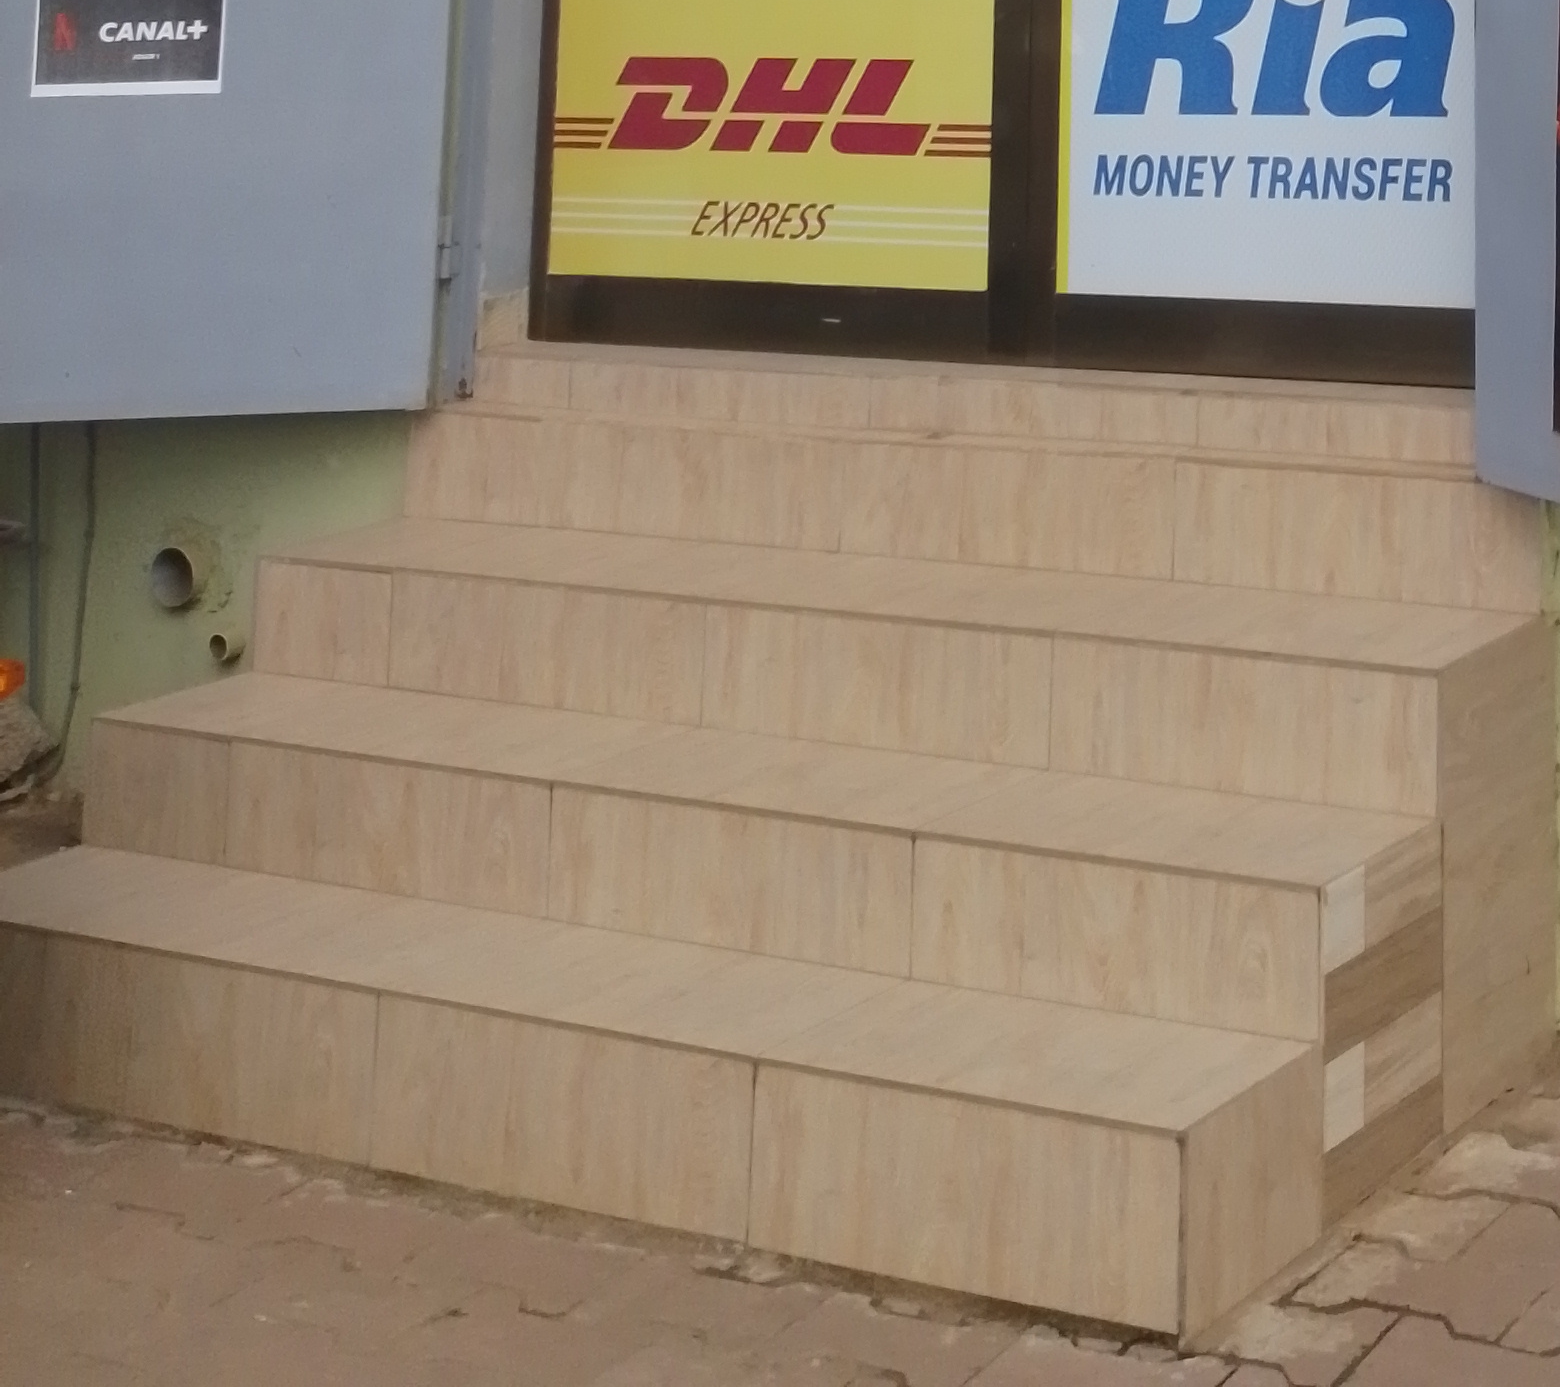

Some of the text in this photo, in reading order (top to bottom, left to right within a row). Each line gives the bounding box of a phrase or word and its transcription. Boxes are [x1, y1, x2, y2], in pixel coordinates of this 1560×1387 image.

[98, 20, 208, 43] CANAL+
[607, 57, 931, 156] DHL
[1093, 155, 1453, 203] MONEY TRANSFER
[691, 200, 834, 240] EXPRESS
